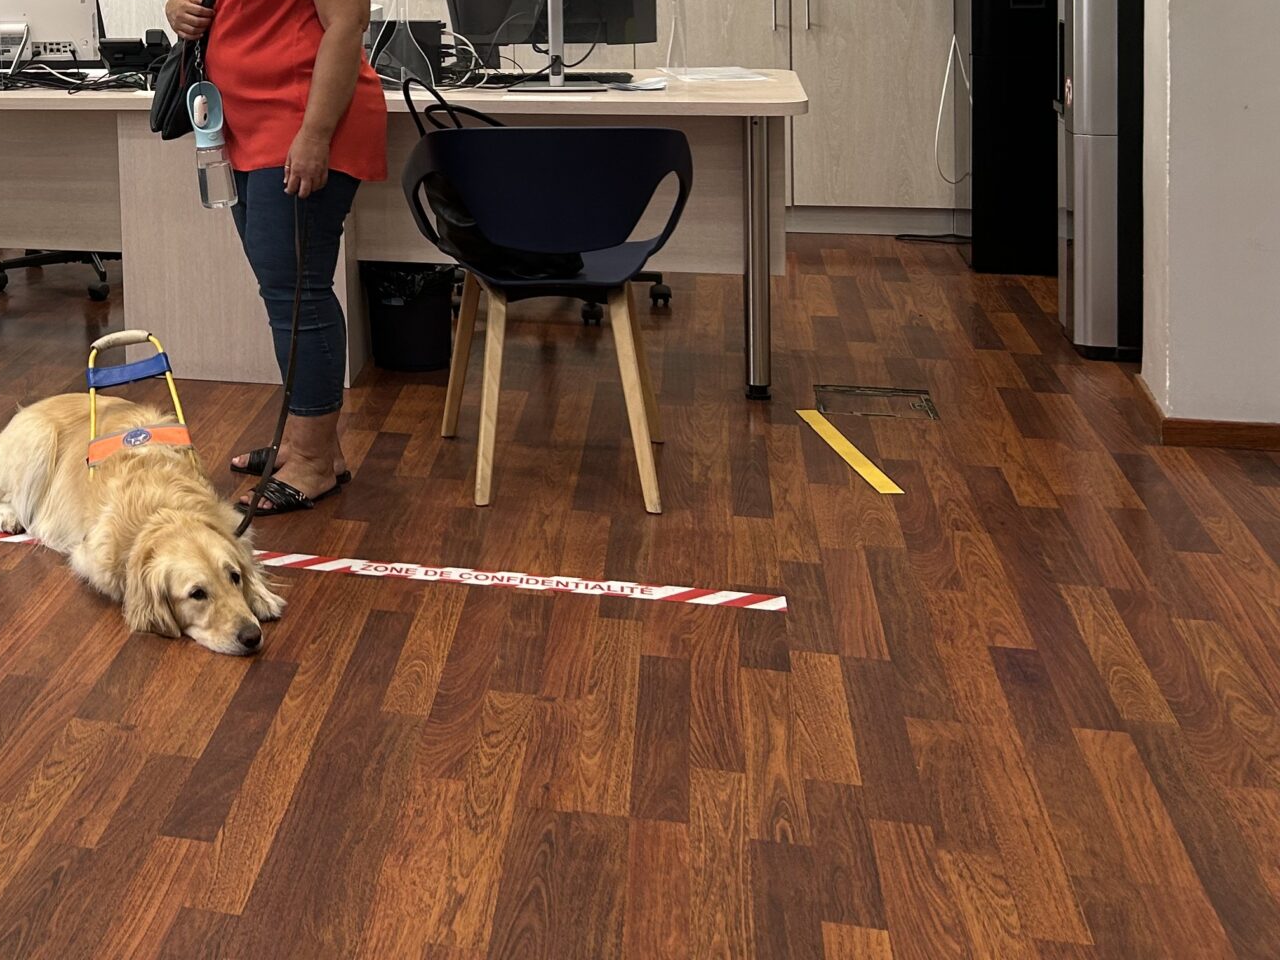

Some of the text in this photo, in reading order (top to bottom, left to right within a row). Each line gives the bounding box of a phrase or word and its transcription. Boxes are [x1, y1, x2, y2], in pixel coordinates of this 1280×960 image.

[360, 564, 654, 596] ZONE DE CONFIDENTIALITÉ
